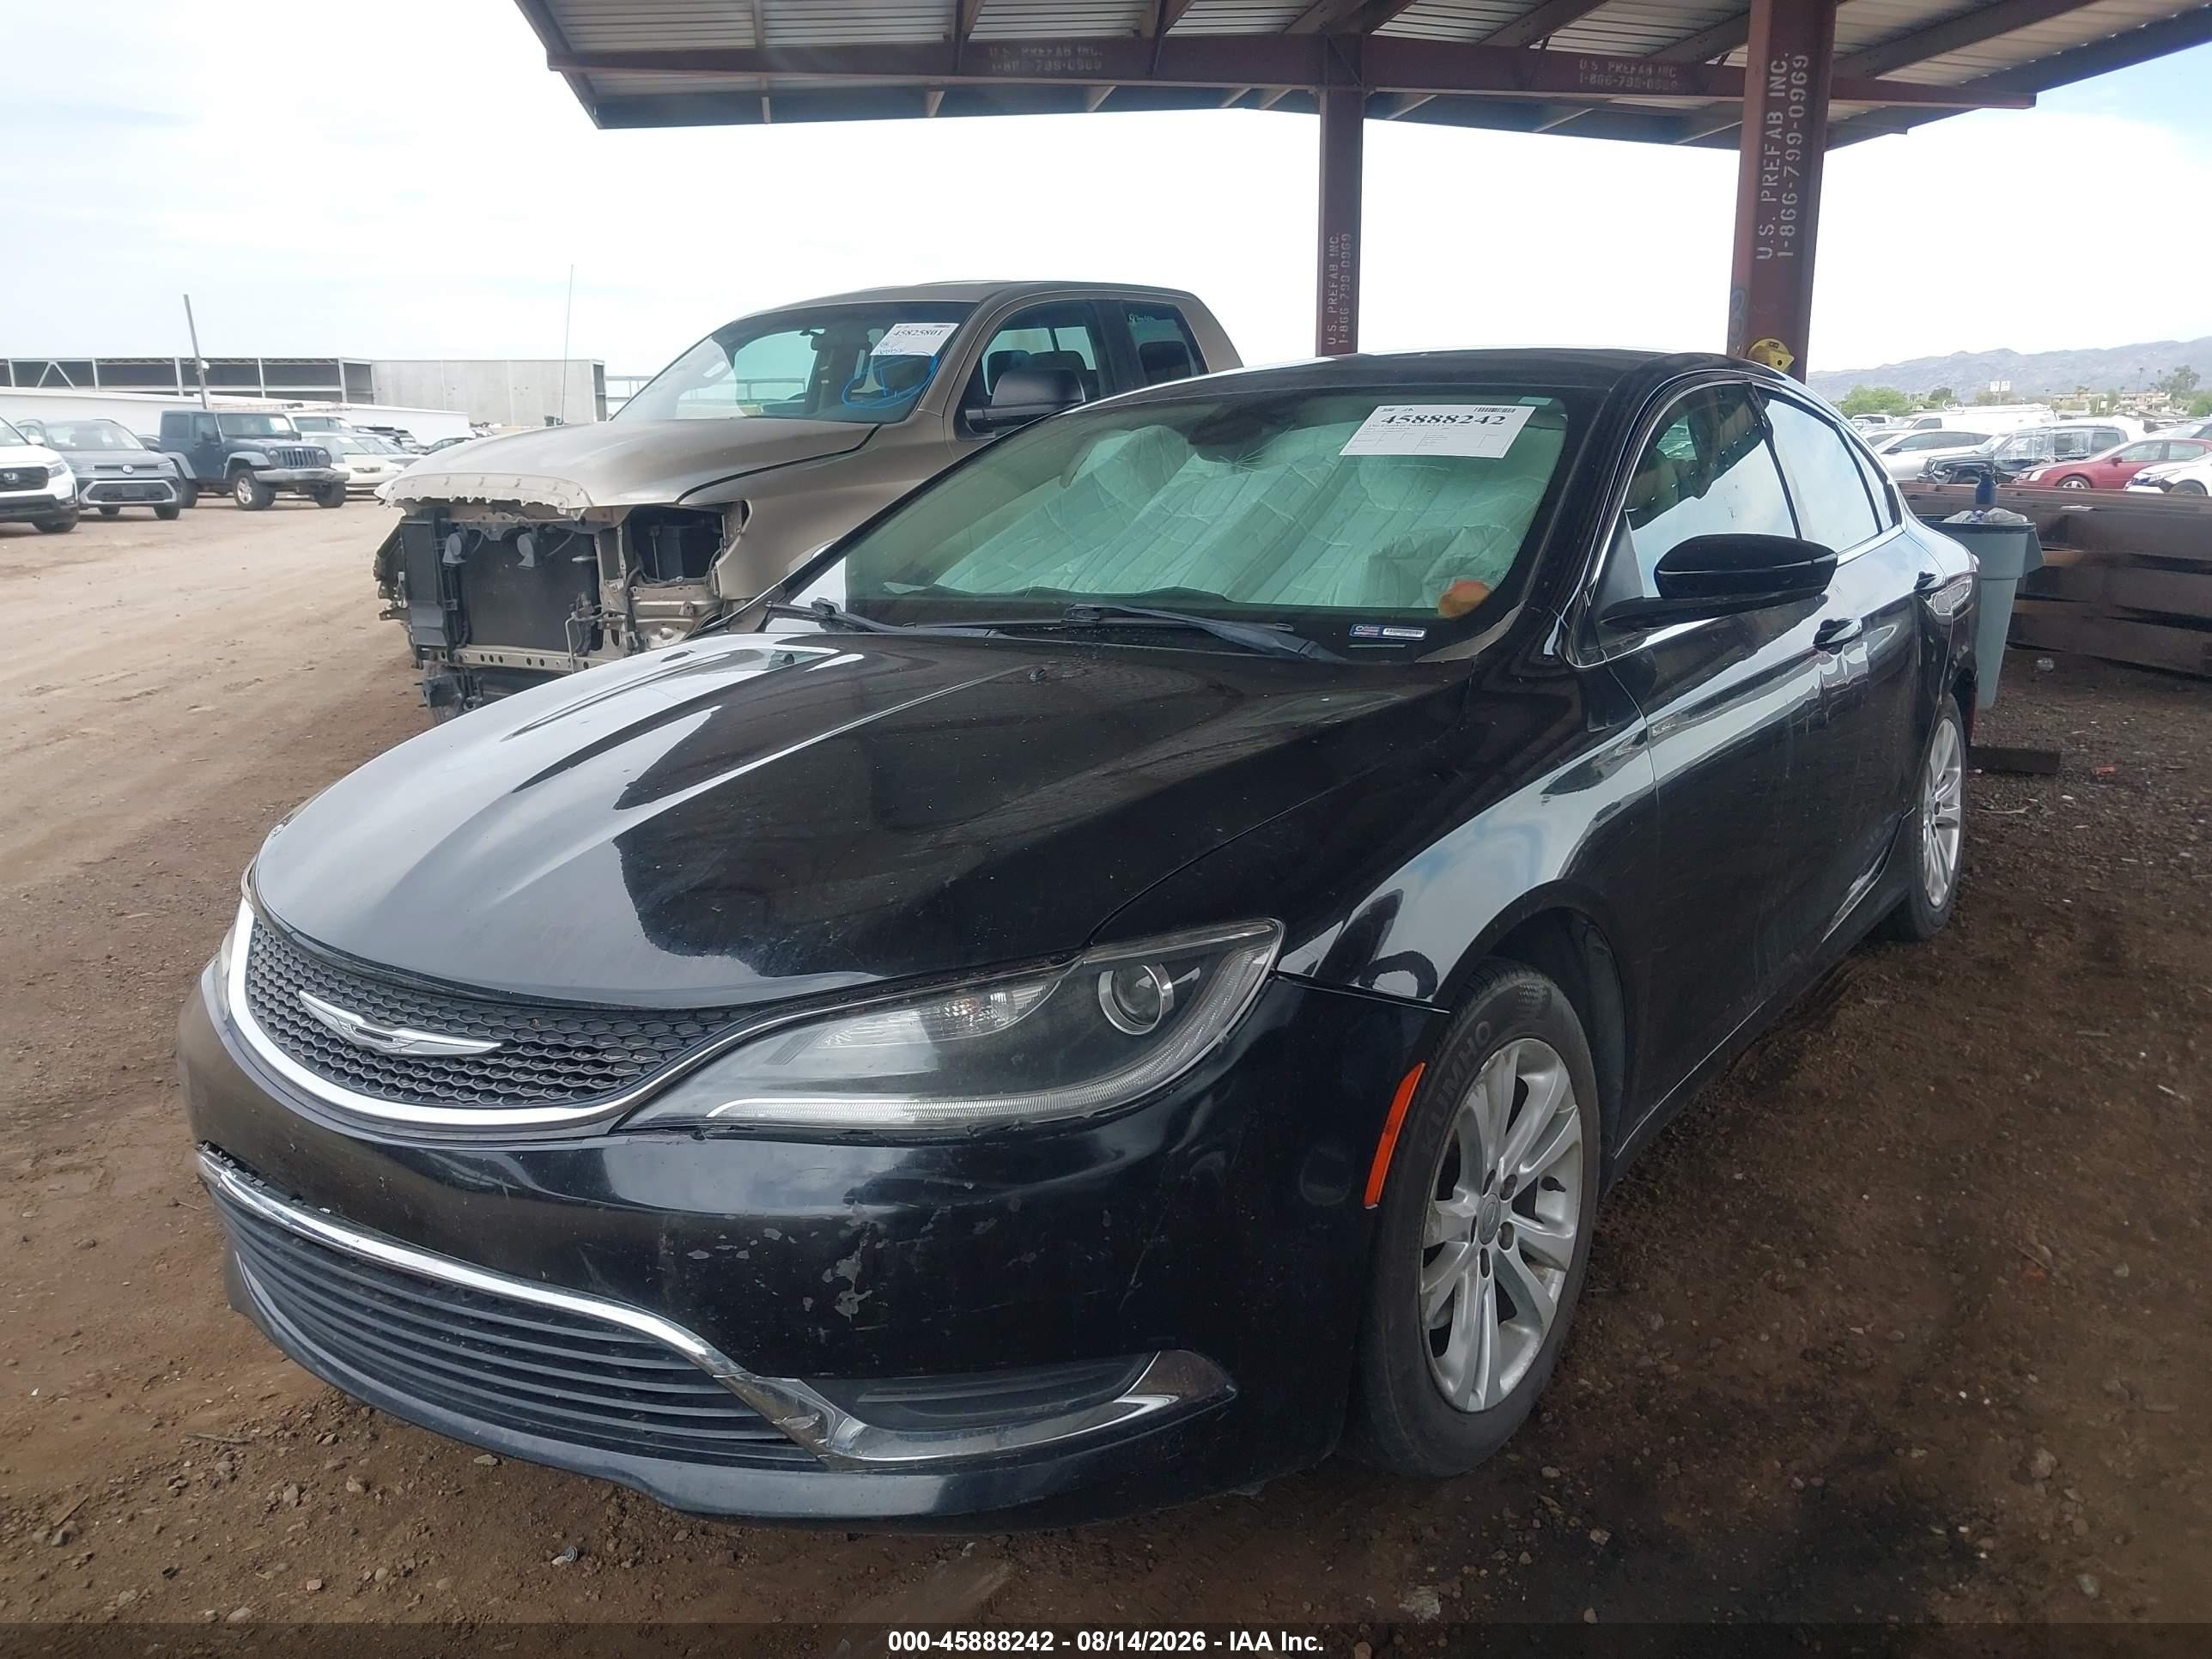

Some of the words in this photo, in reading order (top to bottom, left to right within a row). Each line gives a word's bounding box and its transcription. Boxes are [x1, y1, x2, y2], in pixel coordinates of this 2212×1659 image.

[1768, 52, 1790, 97] INC.
[1760, 110, 1784, 202] PREFAB
[1755, 216, 1776, 259] U.S.
[1327, 264, 1340, 313] PREFAB
[893, 329, 944, 337] 45825801
[1381, 414, 1506, 425] 45888242
